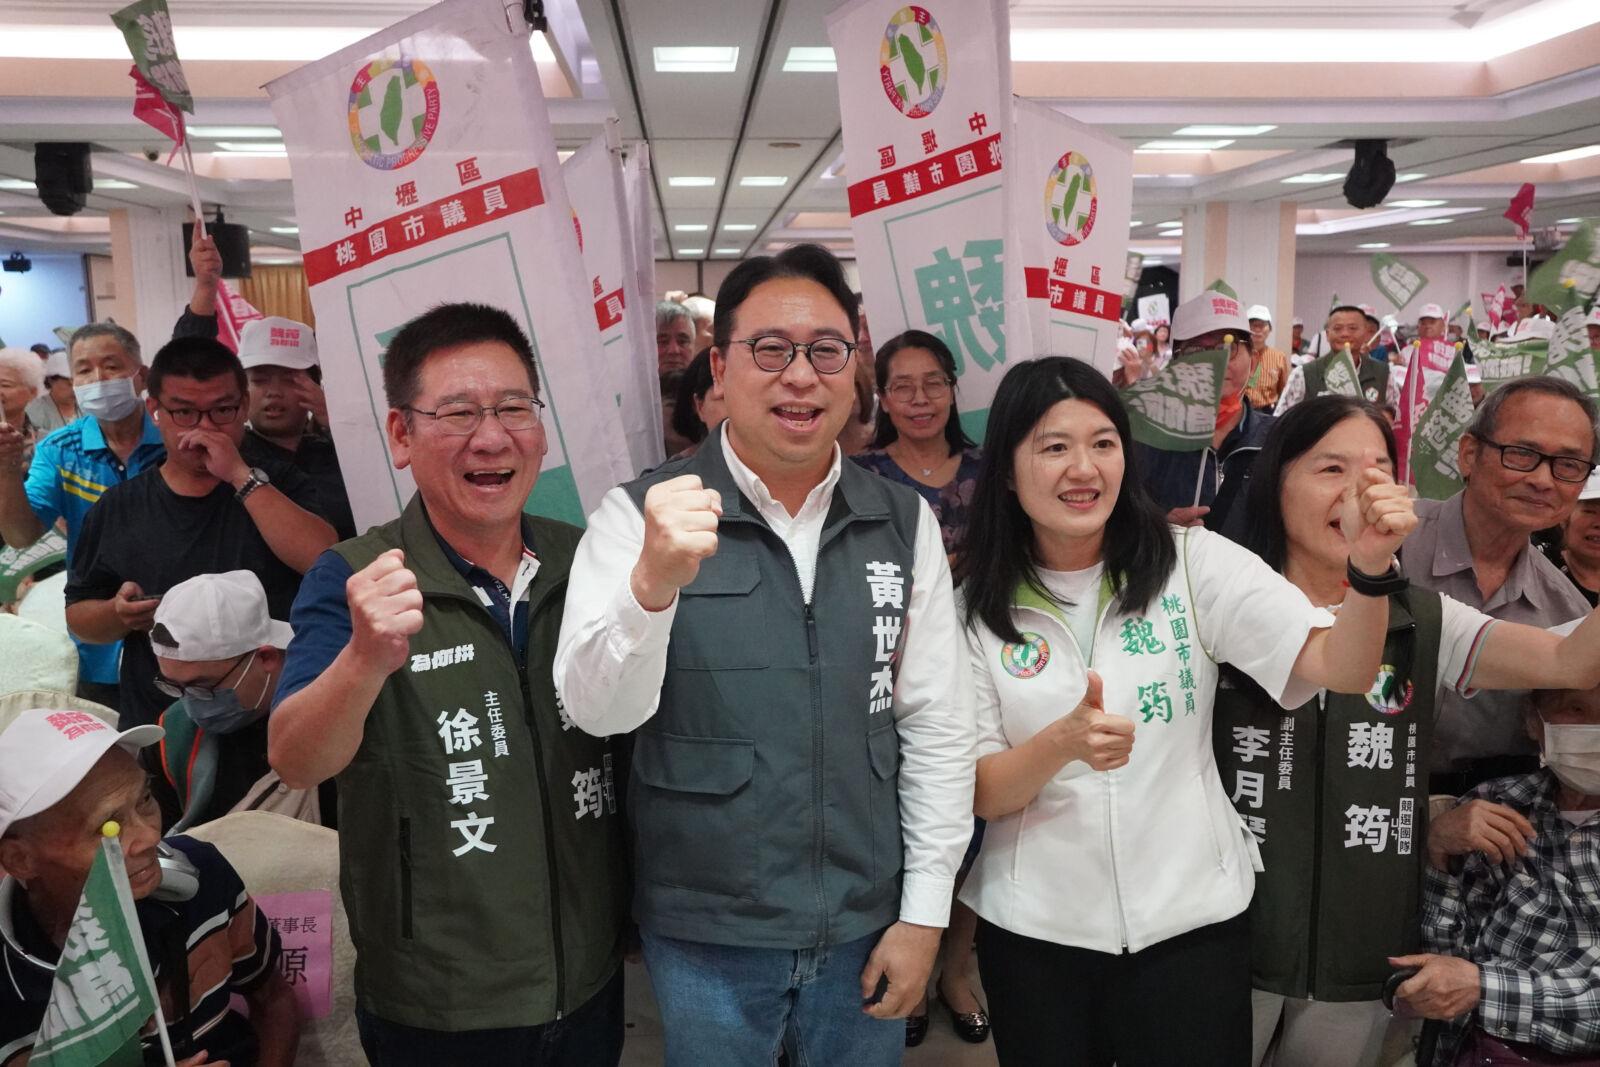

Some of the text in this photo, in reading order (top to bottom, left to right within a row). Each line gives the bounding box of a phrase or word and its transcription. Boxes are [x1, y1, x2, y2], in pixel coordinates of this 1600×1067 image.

[336, 185, 508, 267] 桃園市議員
[344, 156, 482, 229] 中壢區
[411, 643, 475, 672] 為你拼
[866, 561, 904, 715] 黃世杰
[1120, 617, 1173, 723] 魏筠
[1161, 593, 1197, 717] 桃園市議員
[484, 690, 510, 758] 主任委員
[1277, 716, 1295, 790] 副主任委員
[436, 708, 497, 857] 徐景文
[1344, 721, 1394, 853] 魏筠
